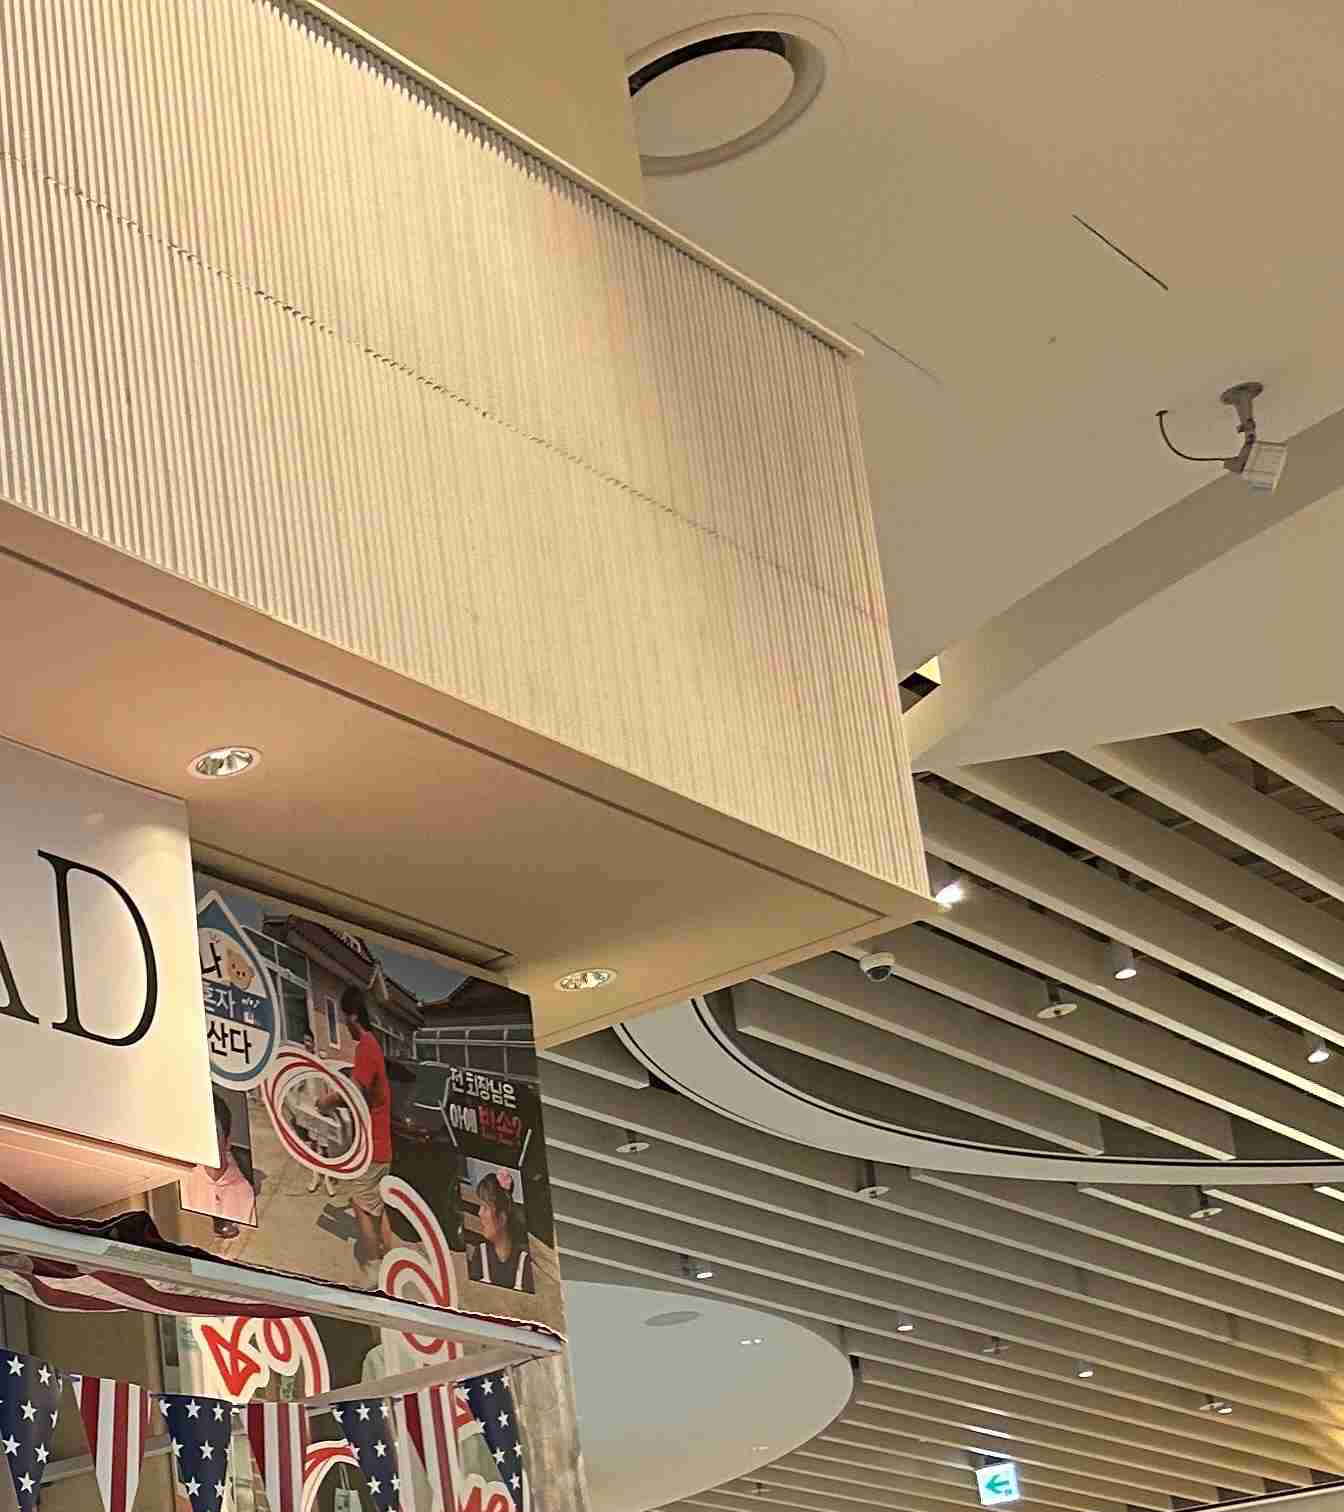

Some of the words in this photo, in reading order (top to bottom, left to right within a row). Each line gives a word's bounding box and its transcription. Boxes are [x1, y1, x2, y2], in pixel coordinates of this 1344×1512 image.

[207, 1020, 252, 1064] 산다
[449, 1067, 465, 1094] 전
[465, 1071, 518, 1109] 회장님은
